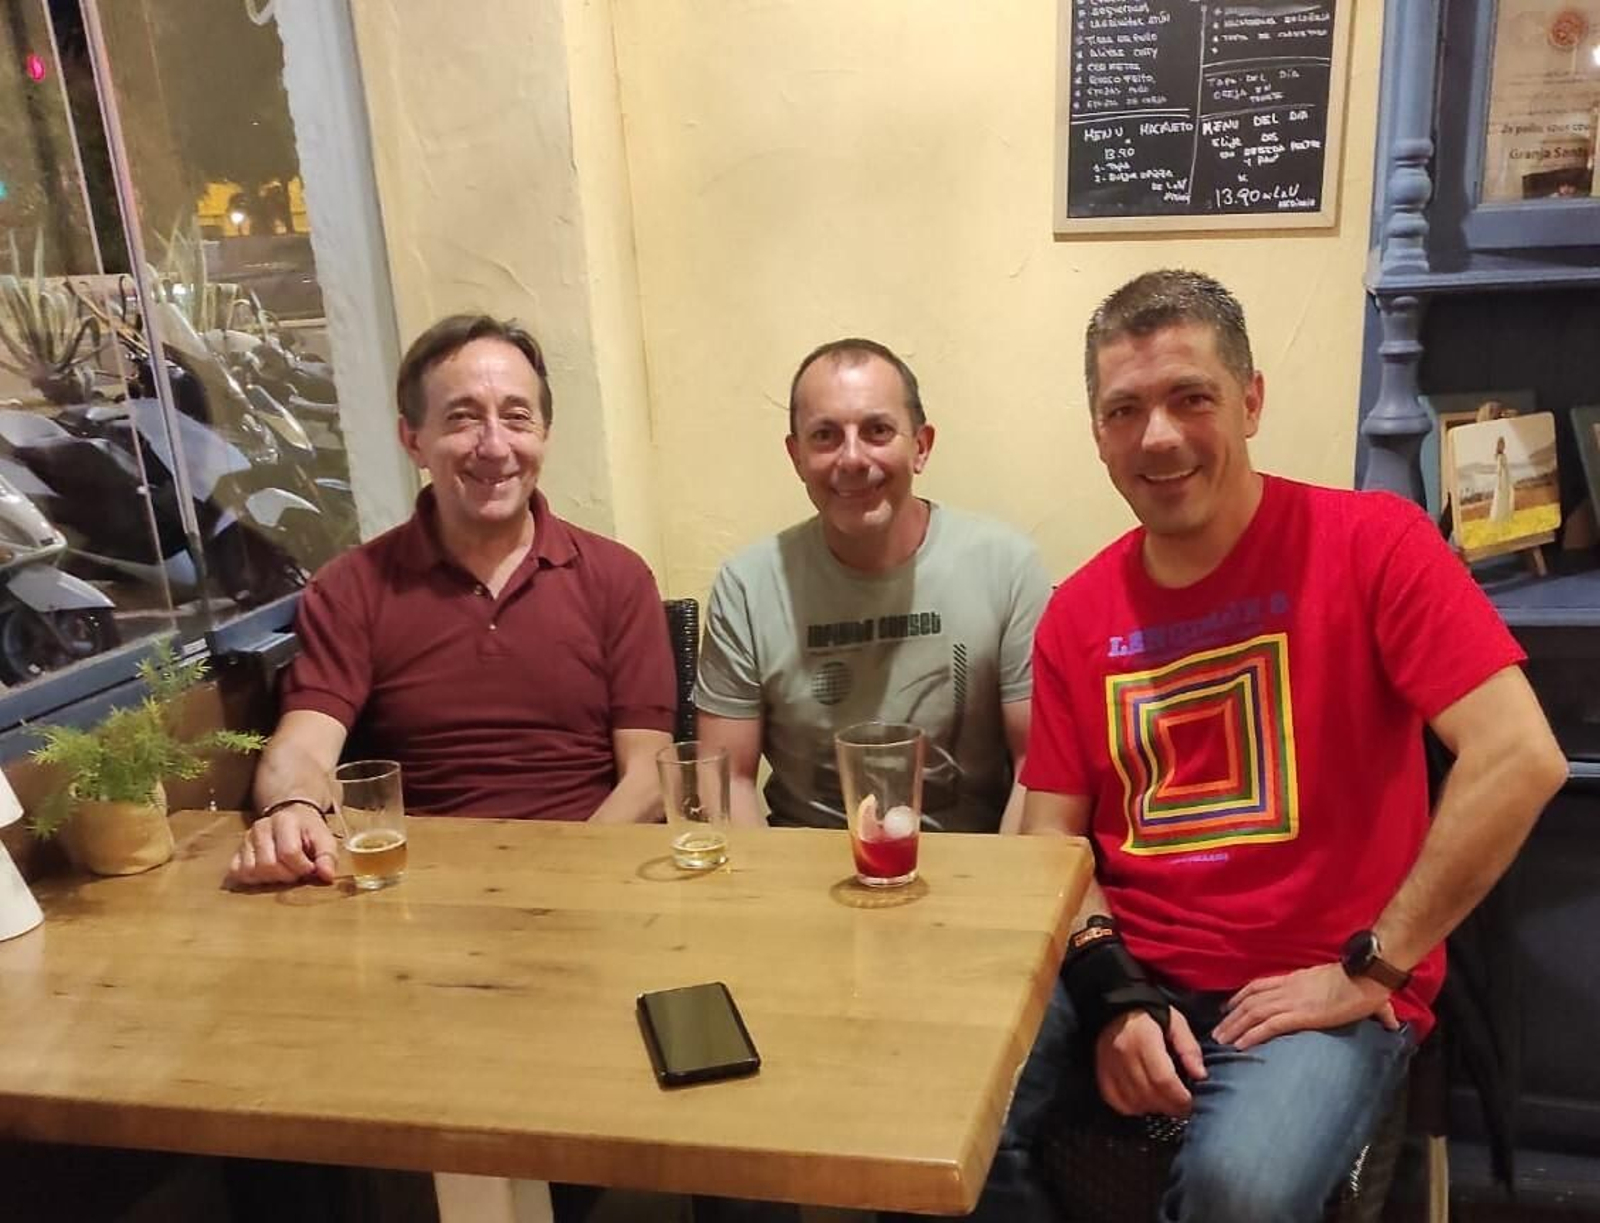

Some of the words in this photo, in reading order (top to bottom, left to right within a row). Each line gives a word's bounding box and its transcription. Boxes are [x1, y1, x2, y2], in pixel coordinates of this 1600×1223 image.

[1202, 119, 1240, 136] MENU
[1253, 112, 1280, 127] DEL
[1215, 186, 1261, 209] 13.90
